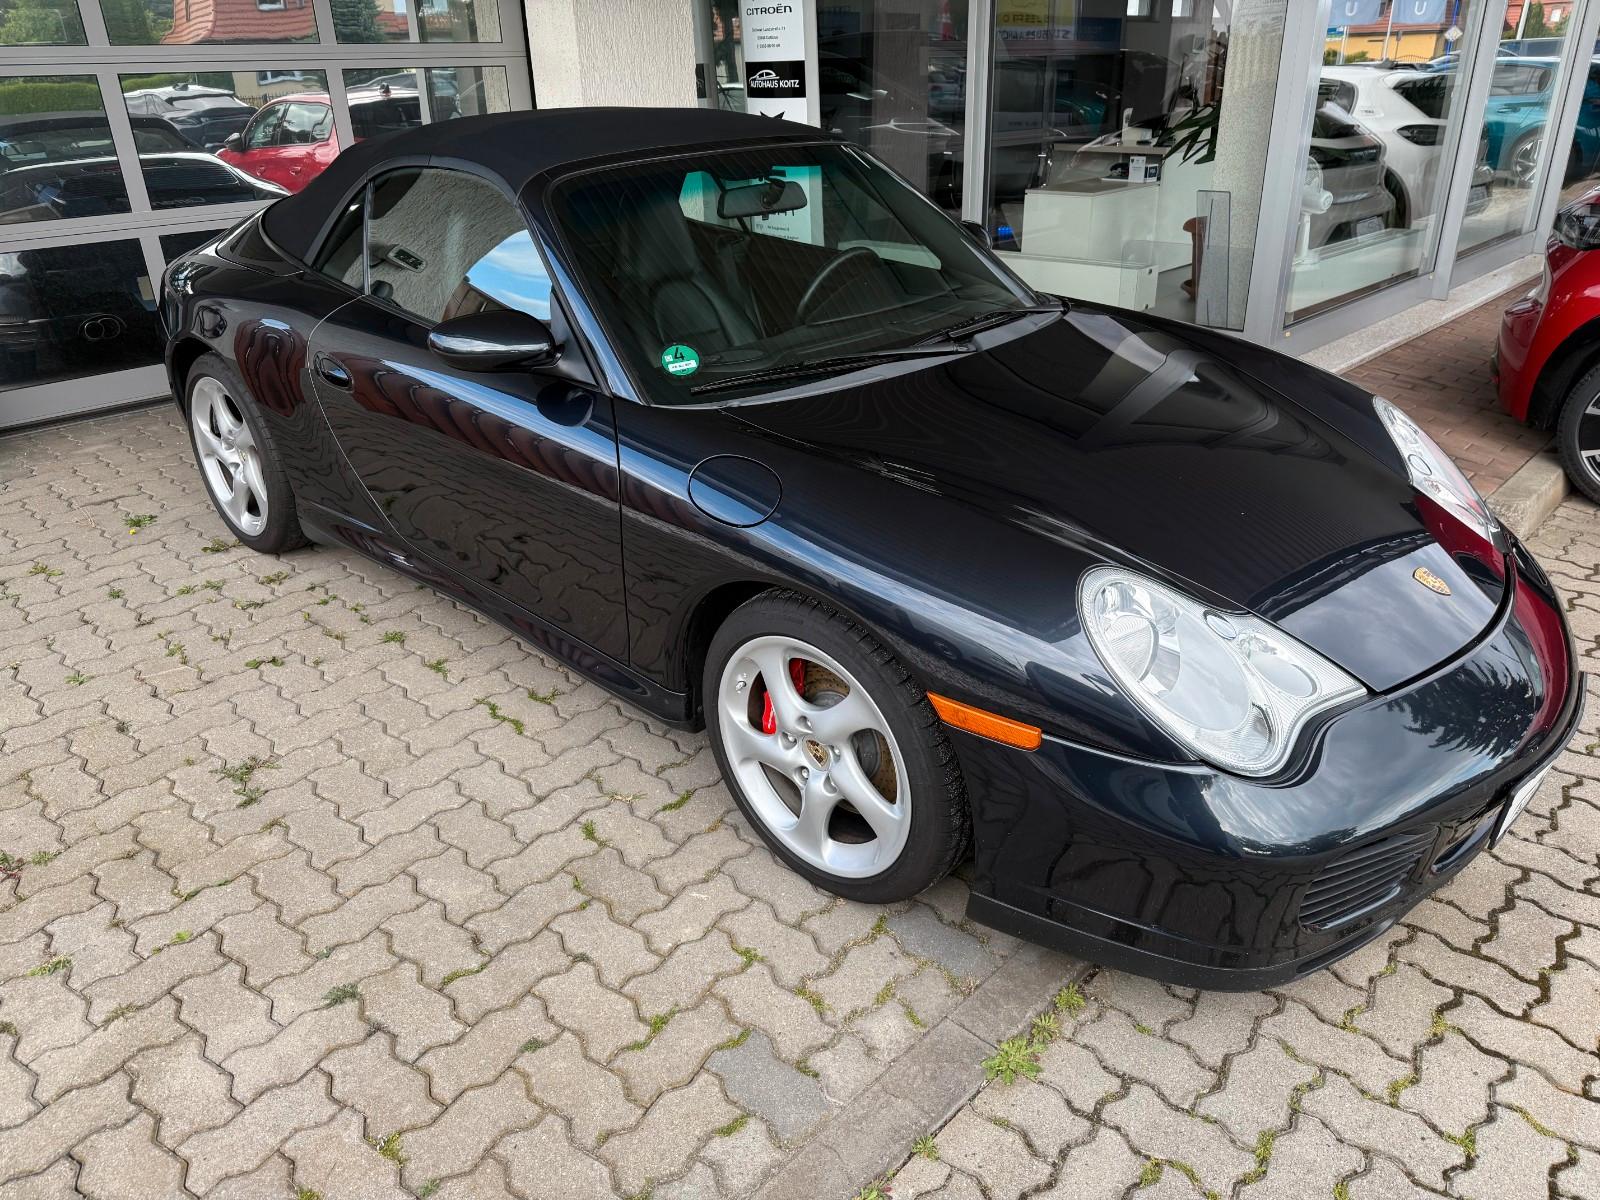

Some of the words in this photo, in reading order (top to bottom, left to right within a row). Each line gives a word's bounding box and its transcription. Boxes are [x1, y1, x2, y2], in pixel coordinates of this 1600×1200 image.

[750, 80, 778, 88] AUTOHAUS
[779, 80, 800, 88] KOITZ
[674, 347, 685, 360] 4
